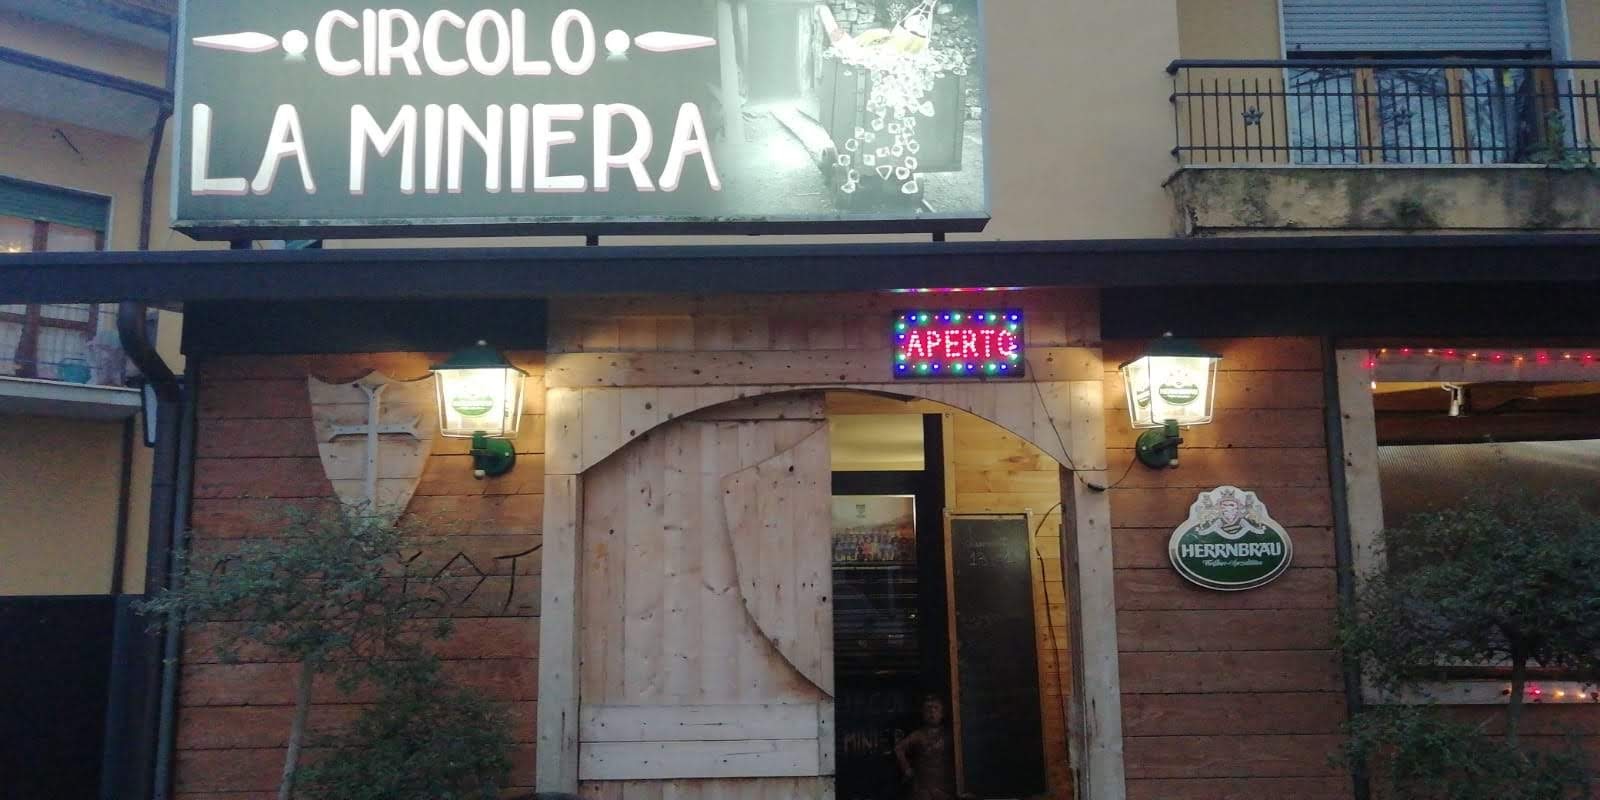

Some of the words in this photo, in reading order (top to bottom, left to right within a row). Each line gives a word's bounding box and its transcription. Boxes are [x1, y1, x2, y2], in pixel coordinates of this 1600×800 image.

[314, 8, 596, 77] CIRCOLO
[191, 102, 317, 196] LA
[349, 102, 722, 195] MINIERA
[906, 329, 1016, 358] APERTO
